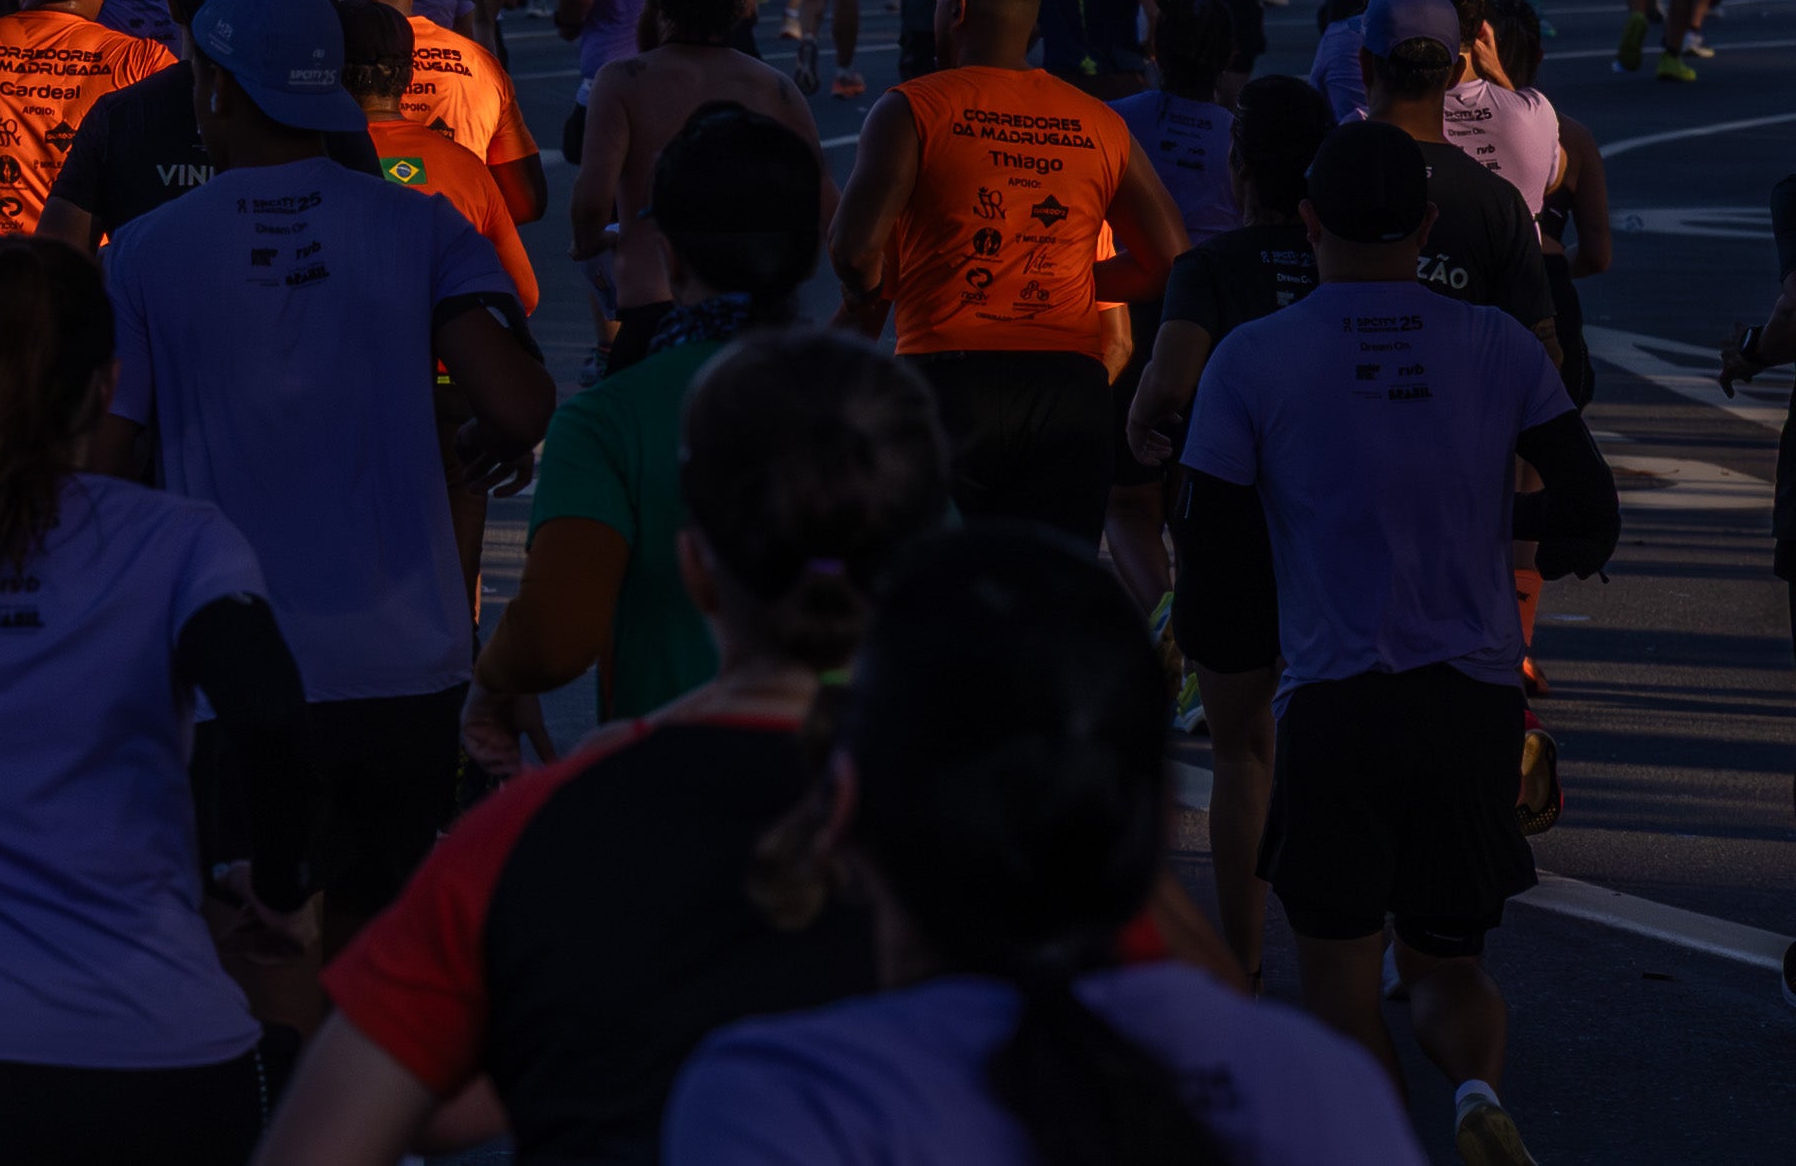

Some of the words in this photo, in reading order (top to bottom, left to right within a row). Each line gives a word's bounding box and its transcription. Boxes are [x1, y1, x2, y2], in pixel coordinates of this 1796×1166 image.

[0, 81, 81, 100] Cardeal
[22, 105, 55, 115] APOIO:
[1473, 107, 1493, 121] 25
[963, 108, 1083, 132] CORREDORES
[952, 122, 976, 137] DA
[980, 126, 1096, 149] MADRUGADA
[988, 149, 1064, 175] Thiago
[1008, 177, 1042, 189] APOIO:
[297, 190, 323, 213] 25
[1356, 317, 1397, 326] SPCITY
[1399, 315, 1424, 332] 25
[1359, 341, 1393, 352] Dream
